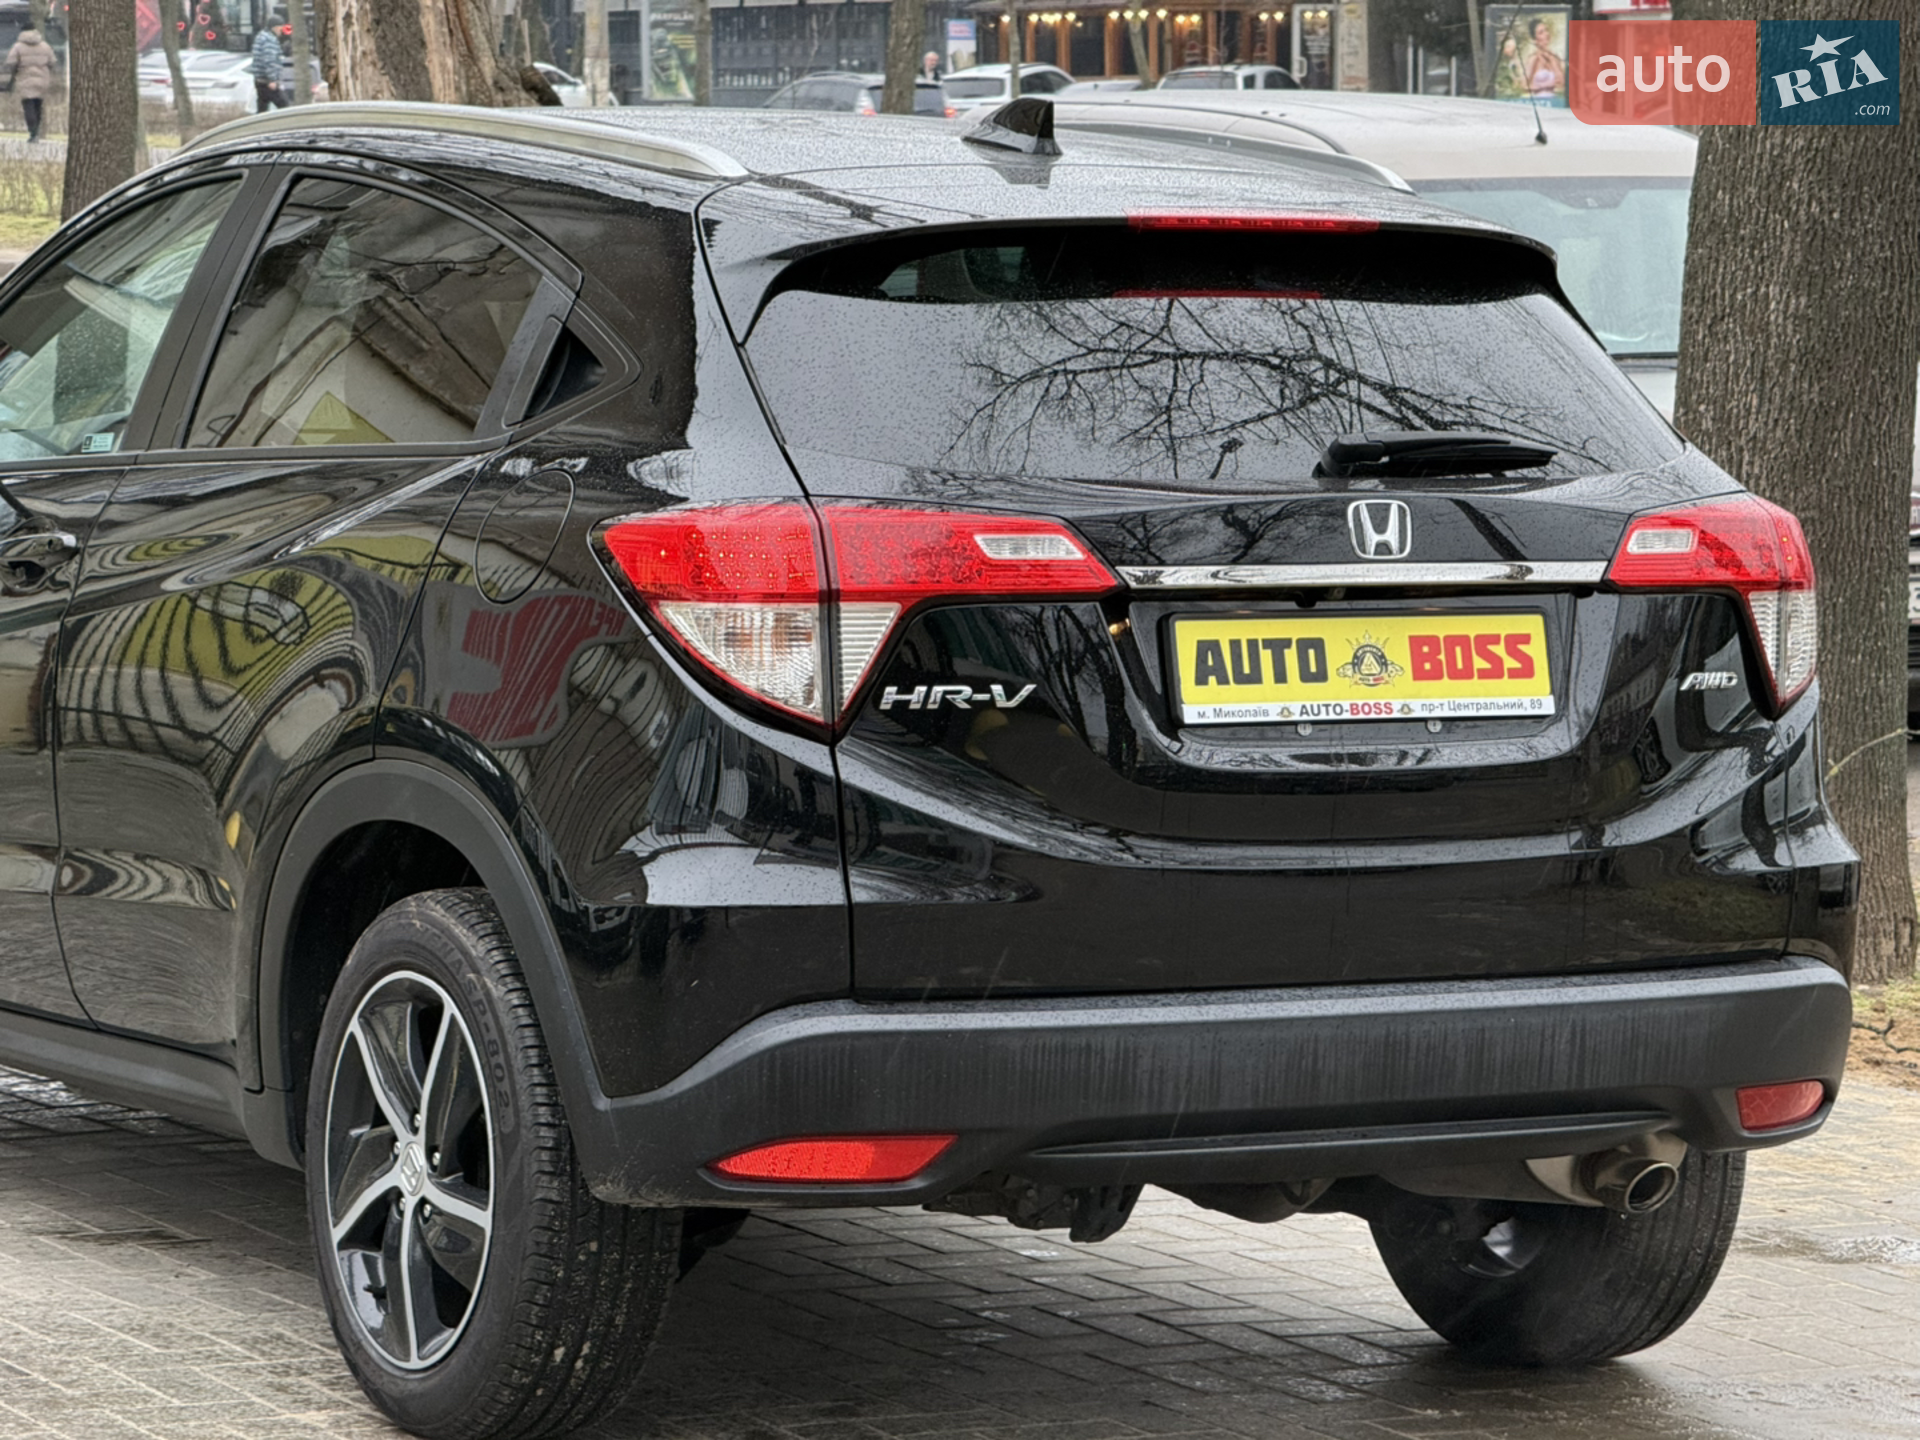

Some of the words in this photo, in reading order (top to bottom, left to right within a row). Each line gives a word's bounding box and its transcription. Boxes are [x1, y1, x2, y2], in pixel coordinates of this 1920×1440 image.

[1194, 637, 1329, 687] AUTO
[1408, 633, 1535, 681] BOSS
[1680, 671, 1738, 691] AWD
[879, 684, 1037, 710] HR-V
[1421, 702, 1444, 714] пр-т
[1448, 699, 1527, 713] Центральний,
[1530, 698, 1542, 710] 89
[1213, 706, 1270, 719] Миколаїв
[1300, 702, 1393, 717] AUTO-BOSS
